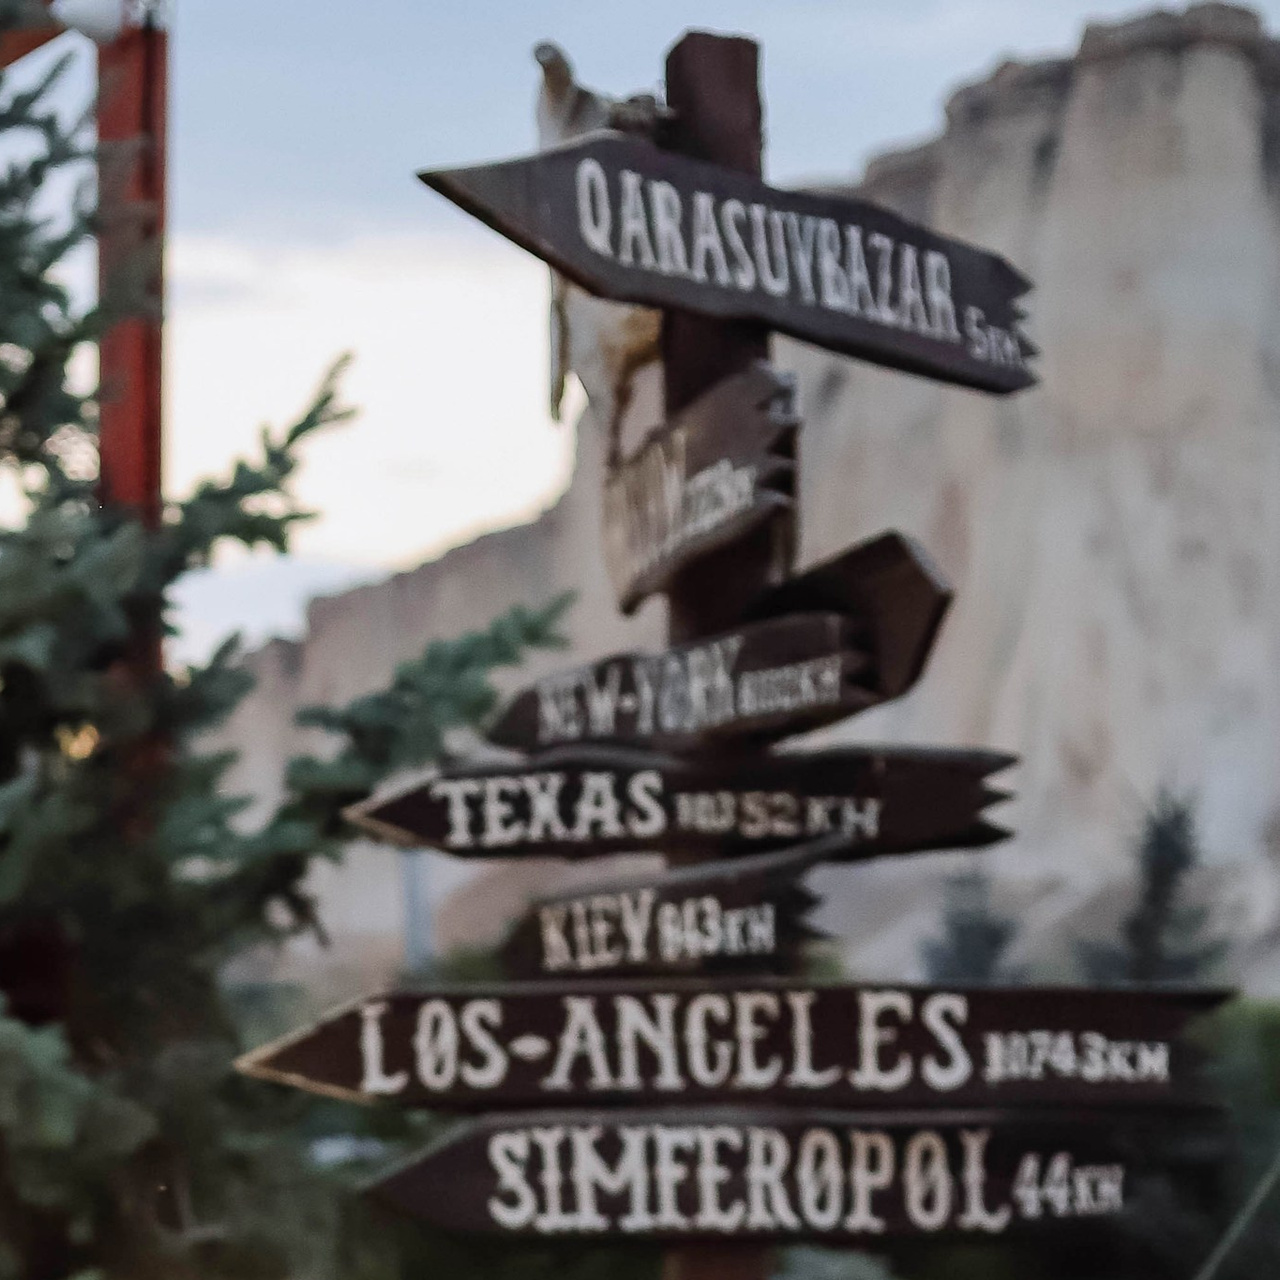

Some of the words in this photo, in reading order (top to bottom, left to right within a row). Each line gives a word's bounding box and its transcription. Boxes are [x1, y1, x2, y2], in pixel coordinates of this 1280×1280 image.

[429, 770, 668, 848] TEXAS
[359, 990, 974, 1094] LOS-ANGELES
[486, 1122, 1012, 1234] SIMFEROPOL
